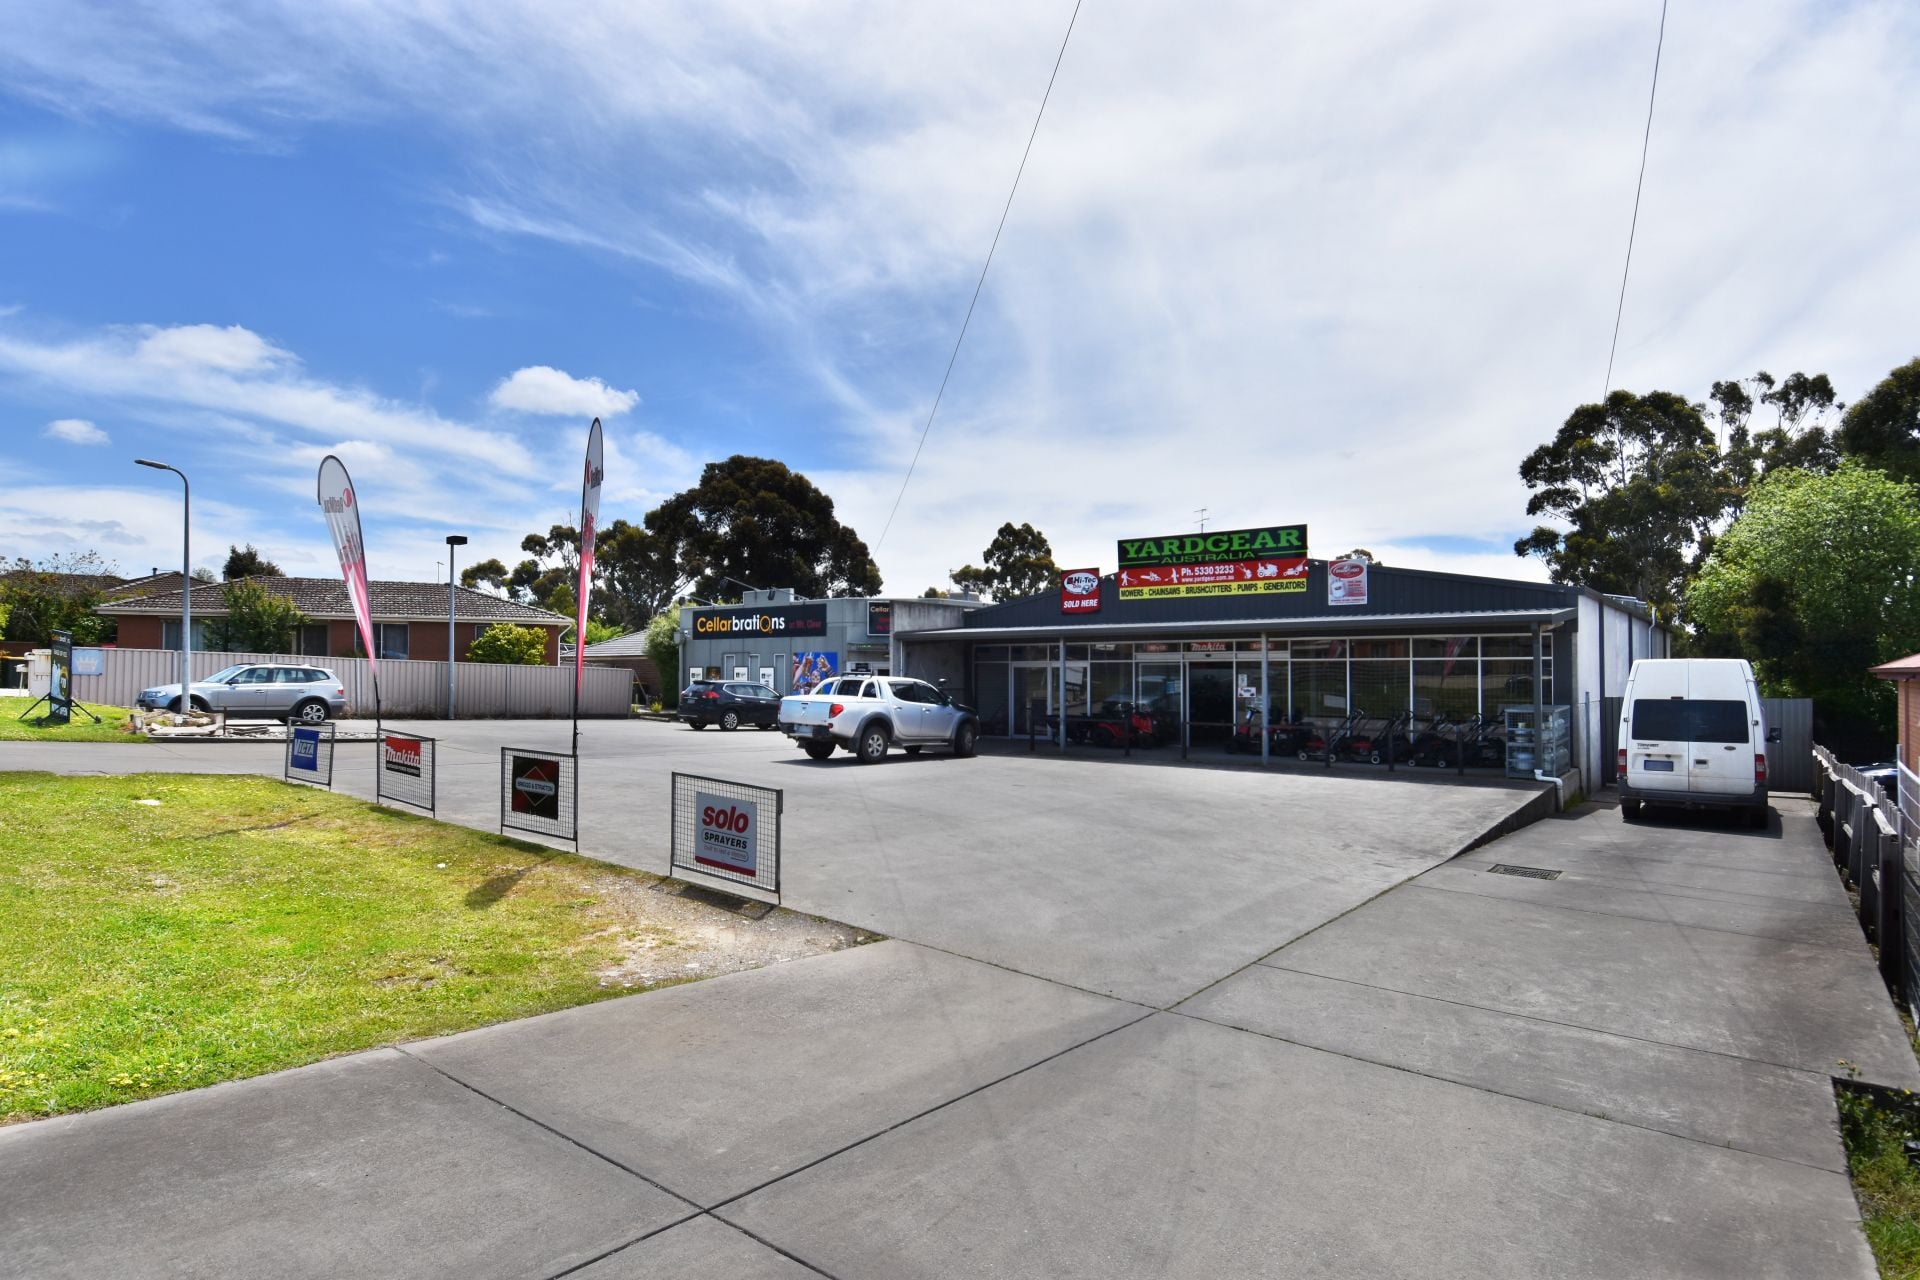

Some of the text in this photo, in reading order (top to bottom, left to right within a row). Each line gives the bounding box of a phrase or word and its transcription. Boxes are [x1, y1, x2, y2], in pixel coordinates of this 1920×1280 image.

[1122, 529, 1302, 558] YARDGEAR
[1160, 551, 1255, 564] AUSTRALIA
[1181, 565, 1235, 577] Ph. 5330 3233
[1074, 576, 1096, 584] Hi-Tec
[1121, 580, 1306, 597] MOWERS CHAINSAWS BRUSHCUTTERS PUMPS GENERATORS
[1063, 598, 1098, 609] SOLD HERE
[294, 738, 315, 757] VICTA
[702, 806, 749, 834] solo
[704, 832, 748, 850] SPRAYERS
